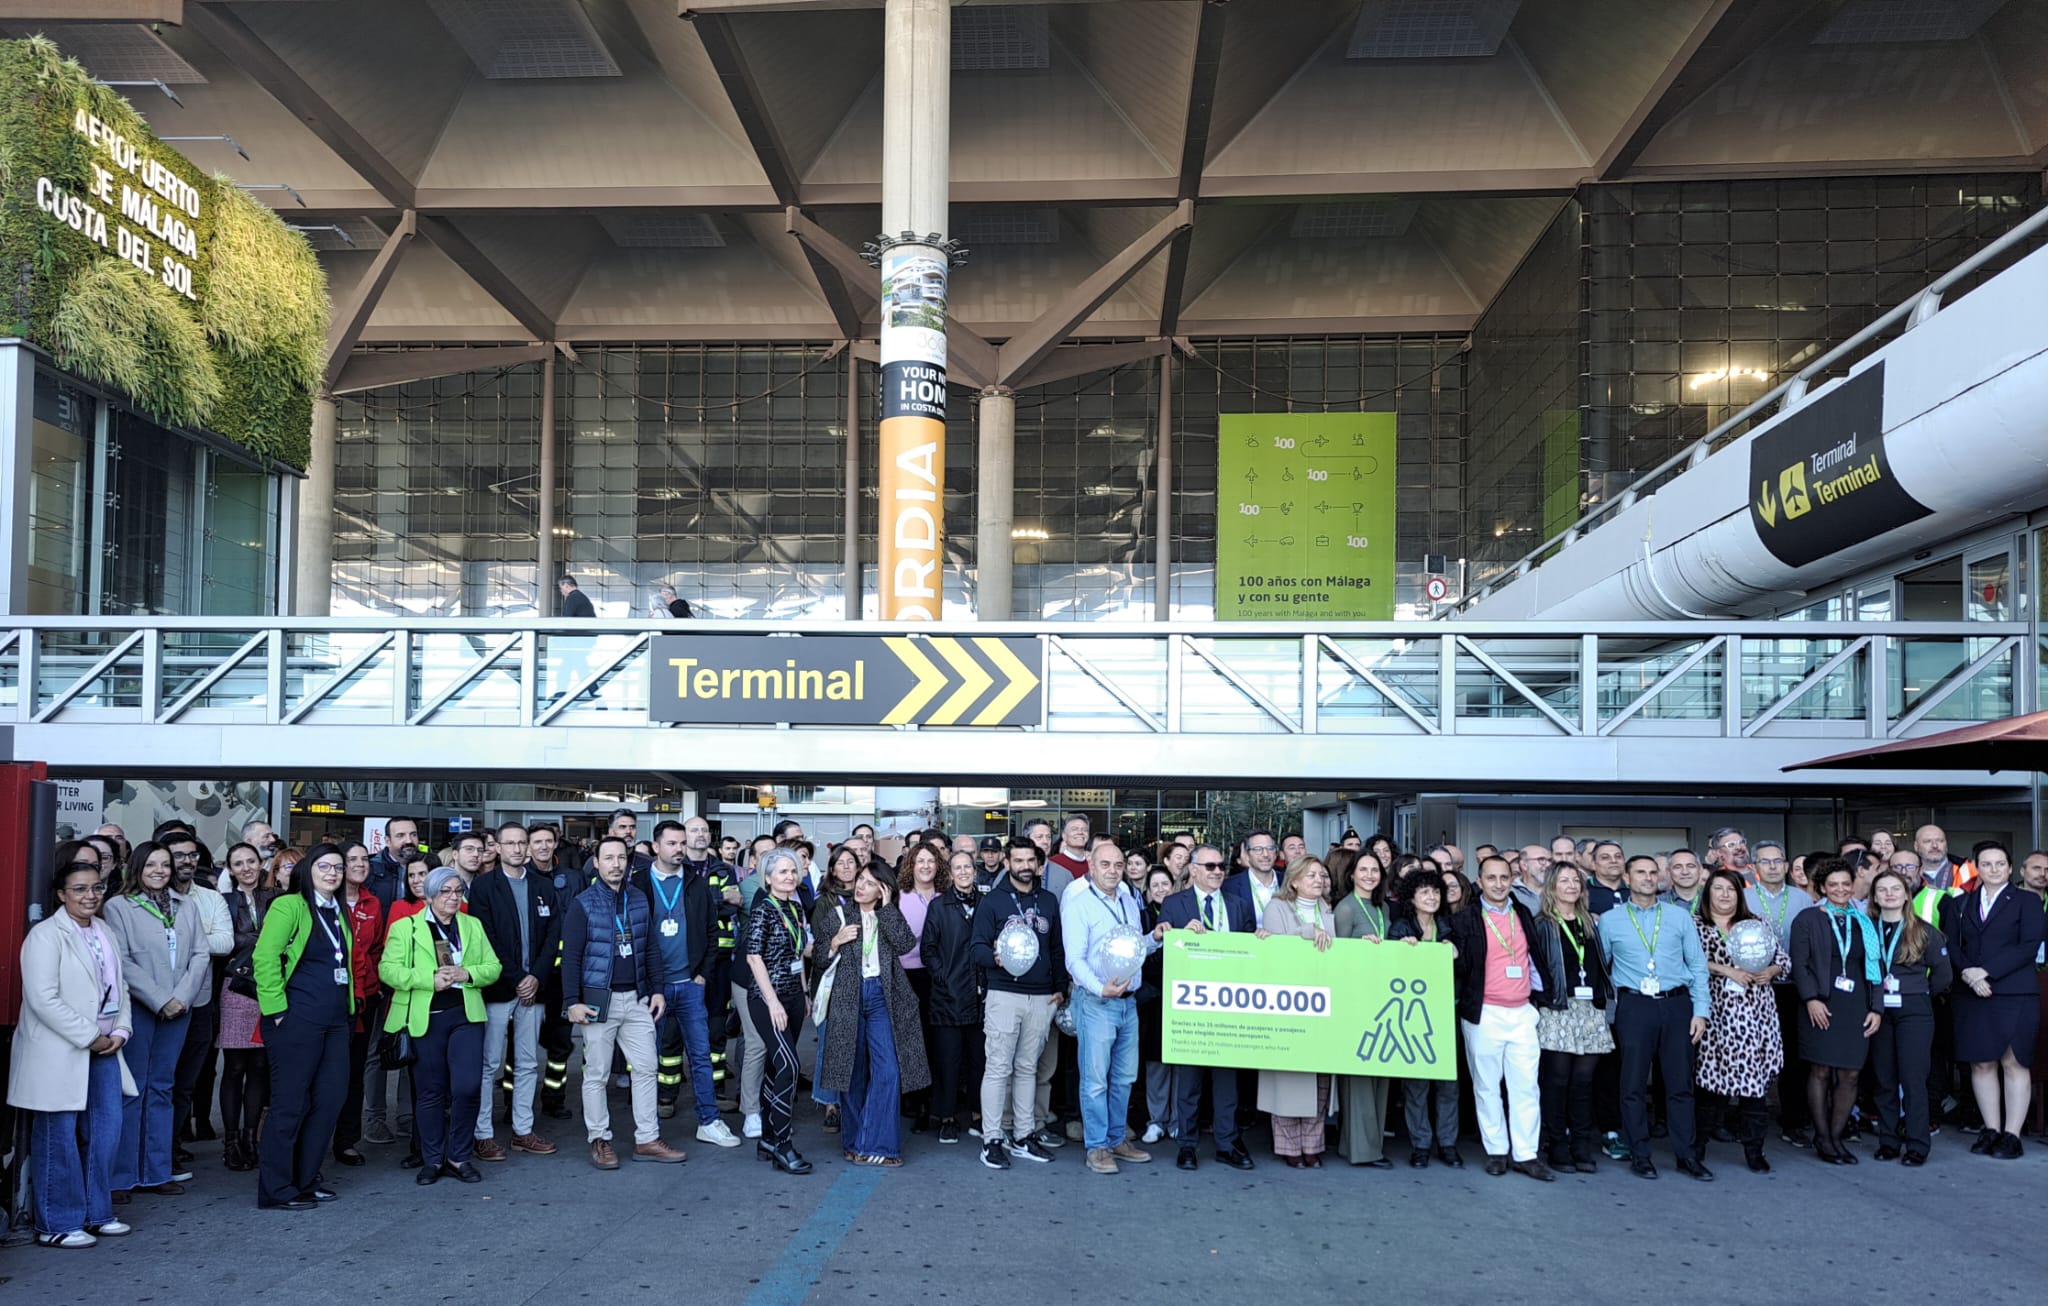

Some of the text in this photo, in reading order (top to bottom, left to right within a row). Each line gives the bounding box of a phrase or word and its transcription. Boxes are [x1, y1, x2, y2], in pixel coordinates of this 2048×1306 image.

[75, 108, 199, 218] AEROPUERTO
[122, 185, 198, 260] MÁLAGA
[37, 177, 197, 300] COSTA DEL SOL
[902, 366, 937, 381] YOUR
[901, 403, 910, 411] IN
[911, 403, 937, 413] COSTA
[1274, 436, 1295, 449] 100
[1811, 432, 1857, 475] Terminal
[1307, 468, 1328, 481] 100
[1813, 454, 1881, 505] Terminal
[1239, 503, 1260, 515] 100
[1346, 535, 1368, 548] 100
[1240, 575, 1371, 589] 100 años con Málaga
[1238, 592, 1330, 604] y con su gente
[668, 658, 864, 700] Terminal
[65, 801, 94, 812] LIVING
[1176, 983, 1326, 1013] 25.000.000
